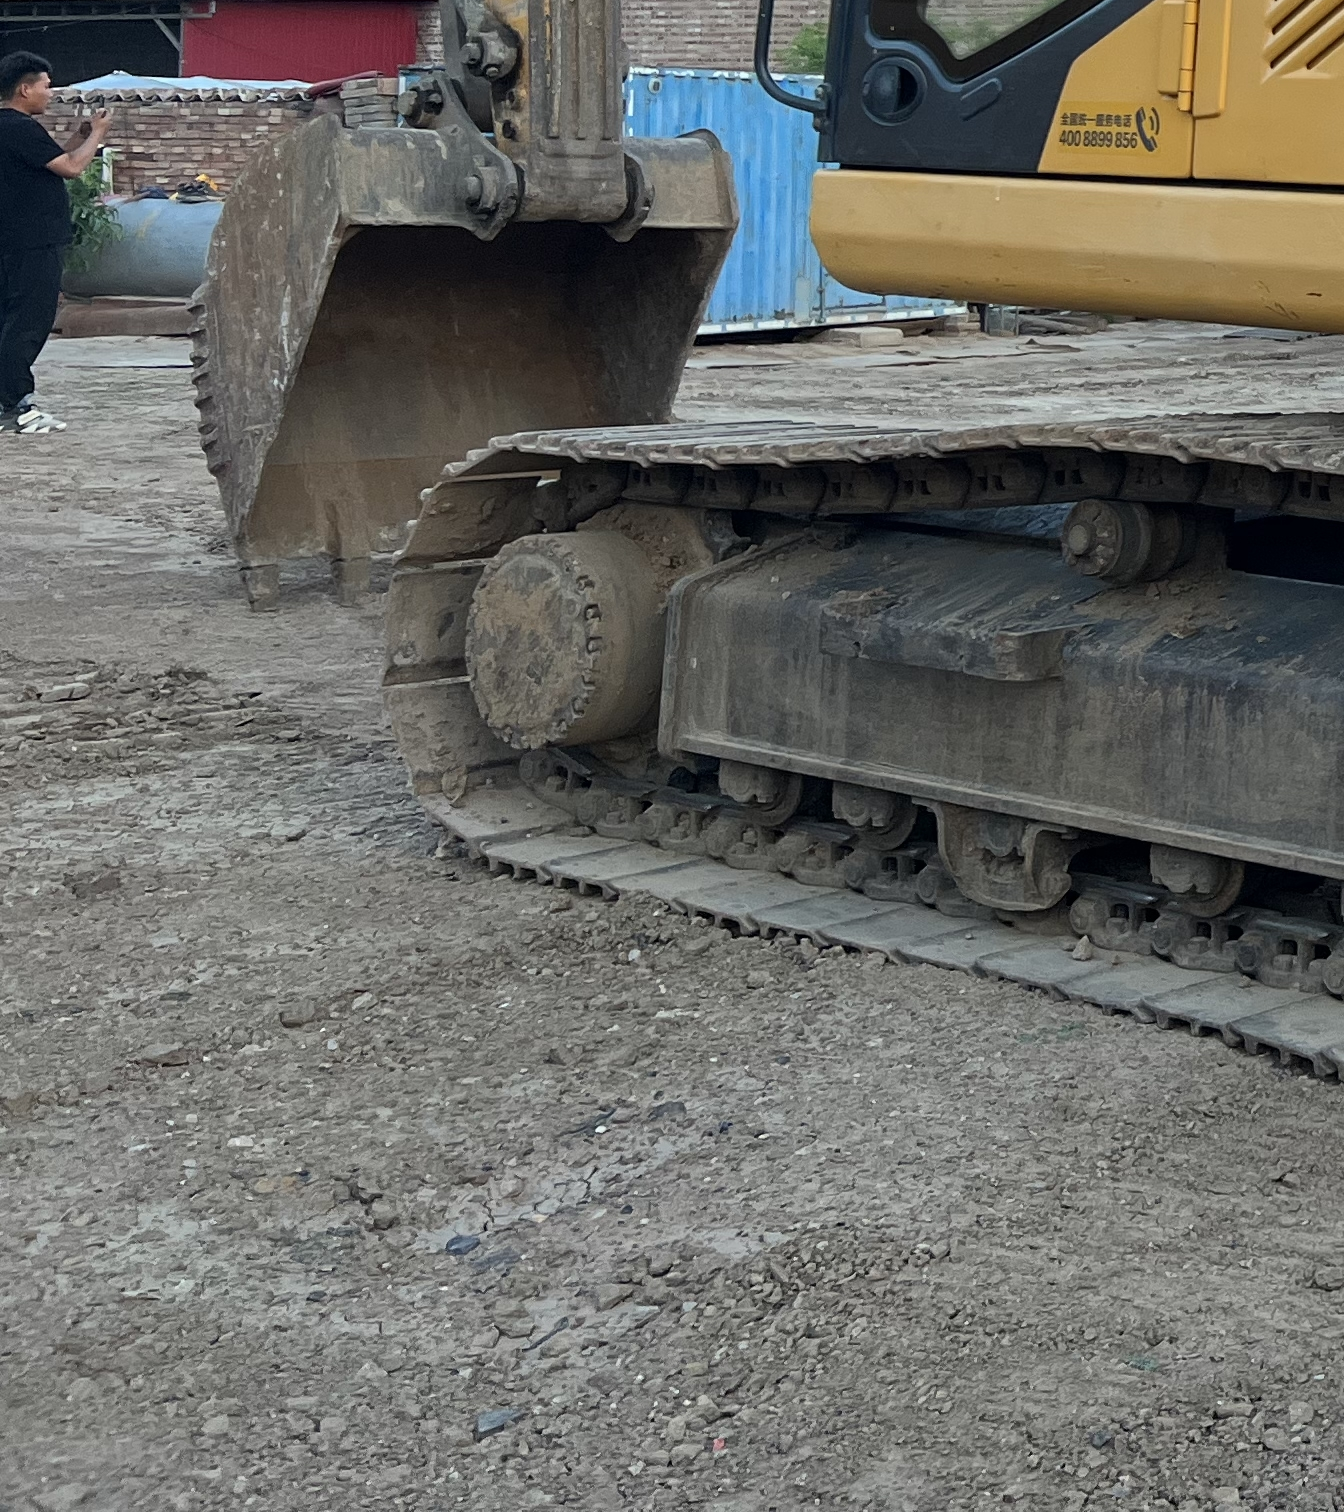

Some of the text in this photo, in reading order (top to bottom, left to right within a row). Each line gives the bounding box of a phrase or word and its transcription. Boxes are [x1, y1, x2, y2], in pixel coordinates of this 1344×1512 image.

[1059, 130, 1138, 149] 400 8899 856
